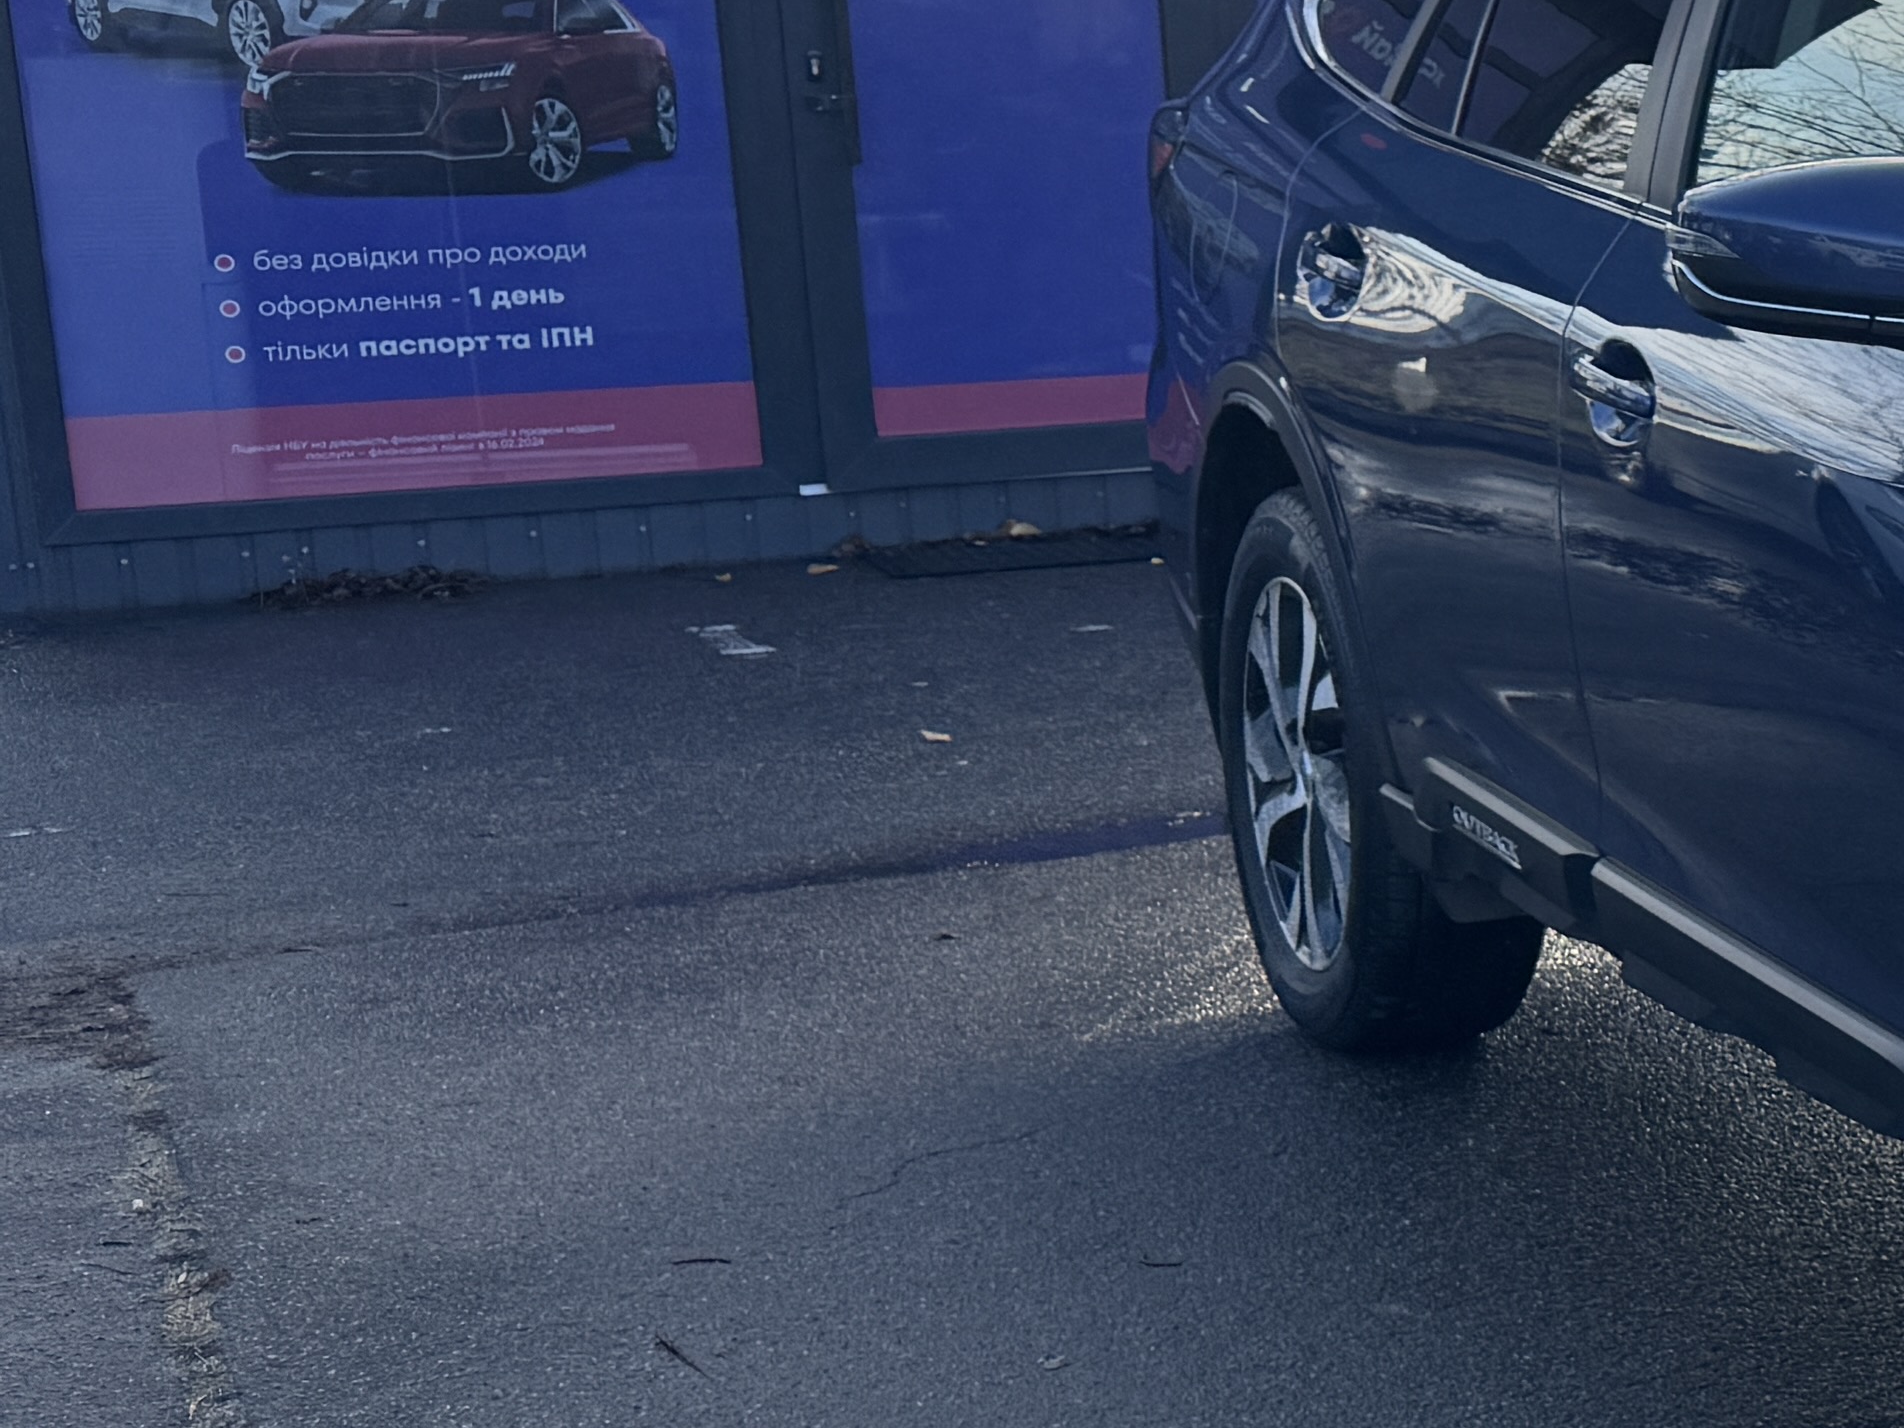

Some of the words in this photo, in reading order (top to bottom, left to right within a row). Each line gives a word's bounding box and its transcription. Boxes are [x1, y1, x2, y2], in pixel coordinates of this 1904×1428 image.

[253, 249, 303, 271] без
[311, 247, 419, 272] довідки
[427, 248, 482, 270] про
[488, 243, 587, 265] доходи
[258, 292, 442, 320] оформлення
[468, 287, 482, 307] 1
[491, 286, 565, 310] день
[263, 340, 349, 362] тільки
[358, 335, 491, 358] паспорт
[496, 334, 531, 350] та
[541, 326, 594, 348] ІПН
